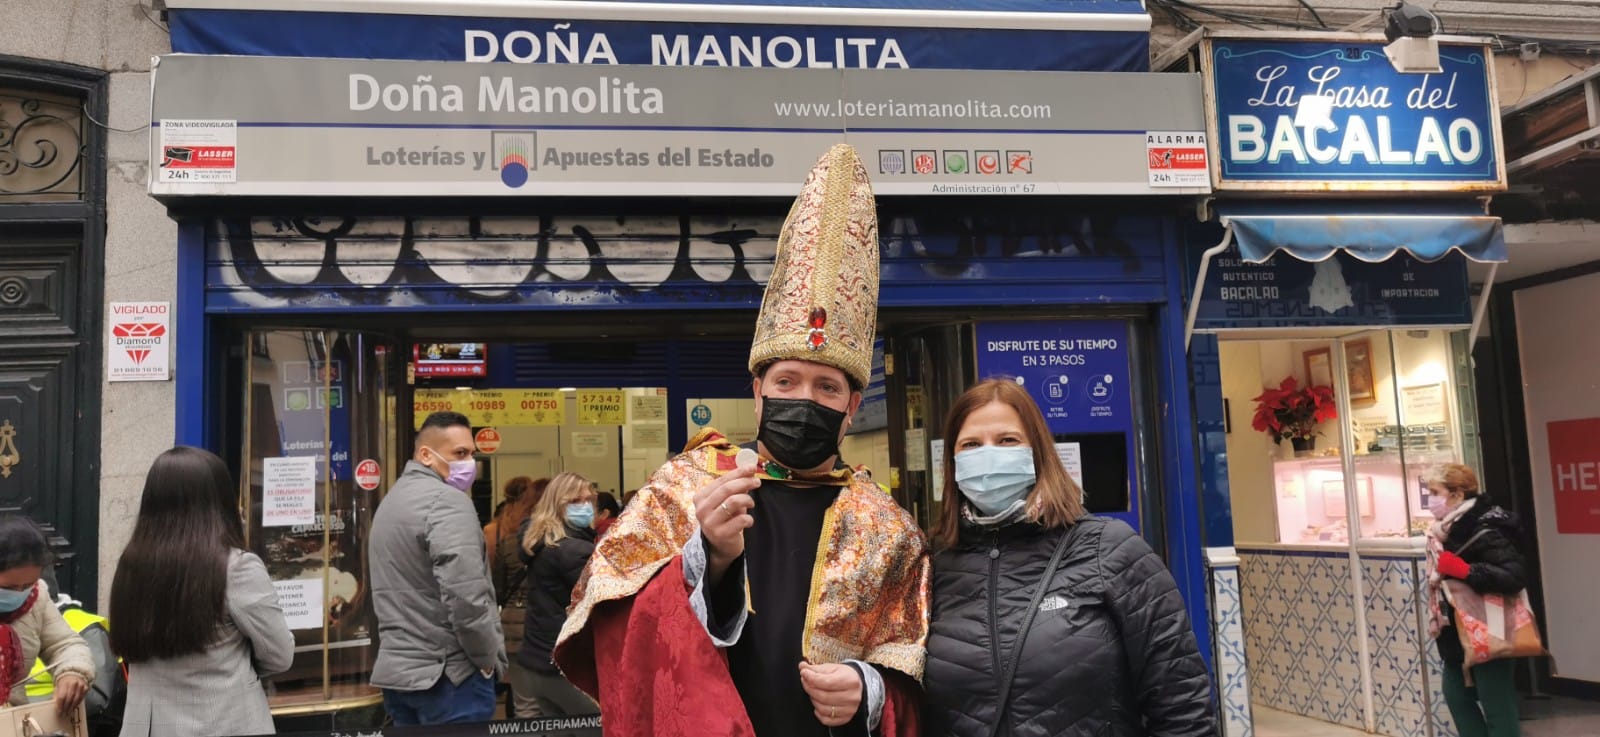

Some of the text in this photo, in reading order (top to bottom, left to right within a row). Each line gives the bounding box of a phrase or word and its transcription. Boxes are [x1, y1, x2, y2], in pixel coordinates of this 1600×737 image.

[464, 22, 911, 70] DOÑA MANOLITA
[1345, 47, 1360, 58] 20
[1247, 65, 1298, 107] La
[1406, 72, 1458, 110] del
[349, 74, 665, 115] Doña Manolita
[774, 99, 1052, 120] www.loteriamanolita.com
[1147, 135, 1205, 144] ALARMA
[1228, 115, 1484, 166] BACALAO
[197, 150, 233, 158] LASSER
[366, 145, 486, 171] Loterías y
[543, 147, 775, 171] Apuestas del Estado
[168, 170, 189, 179] 24h
[1153, 174, 1171, 182] 24h
[1023, 184, 1036, 193] 67
[1222, 272, 1275, 281] AUTENTICO
[1220, 286, 1280, 300] BACALAO
[1381, 289, 1440, 298] IMPORTACION
[113, 305, 167, 314] VIGILADO
[987, 339, 1117, 351] DISFRUTE DE SU TIEMPO
[1023, 354, 1085, 366] EN 3 PASOS
[415, 402, 453, 411] 26590
[470, 401, 506, 410] 10989
[521, 400, 557, 410] 00750
[332, 452, 348, 461] del
[1556, 462, 1600, 492] HE
